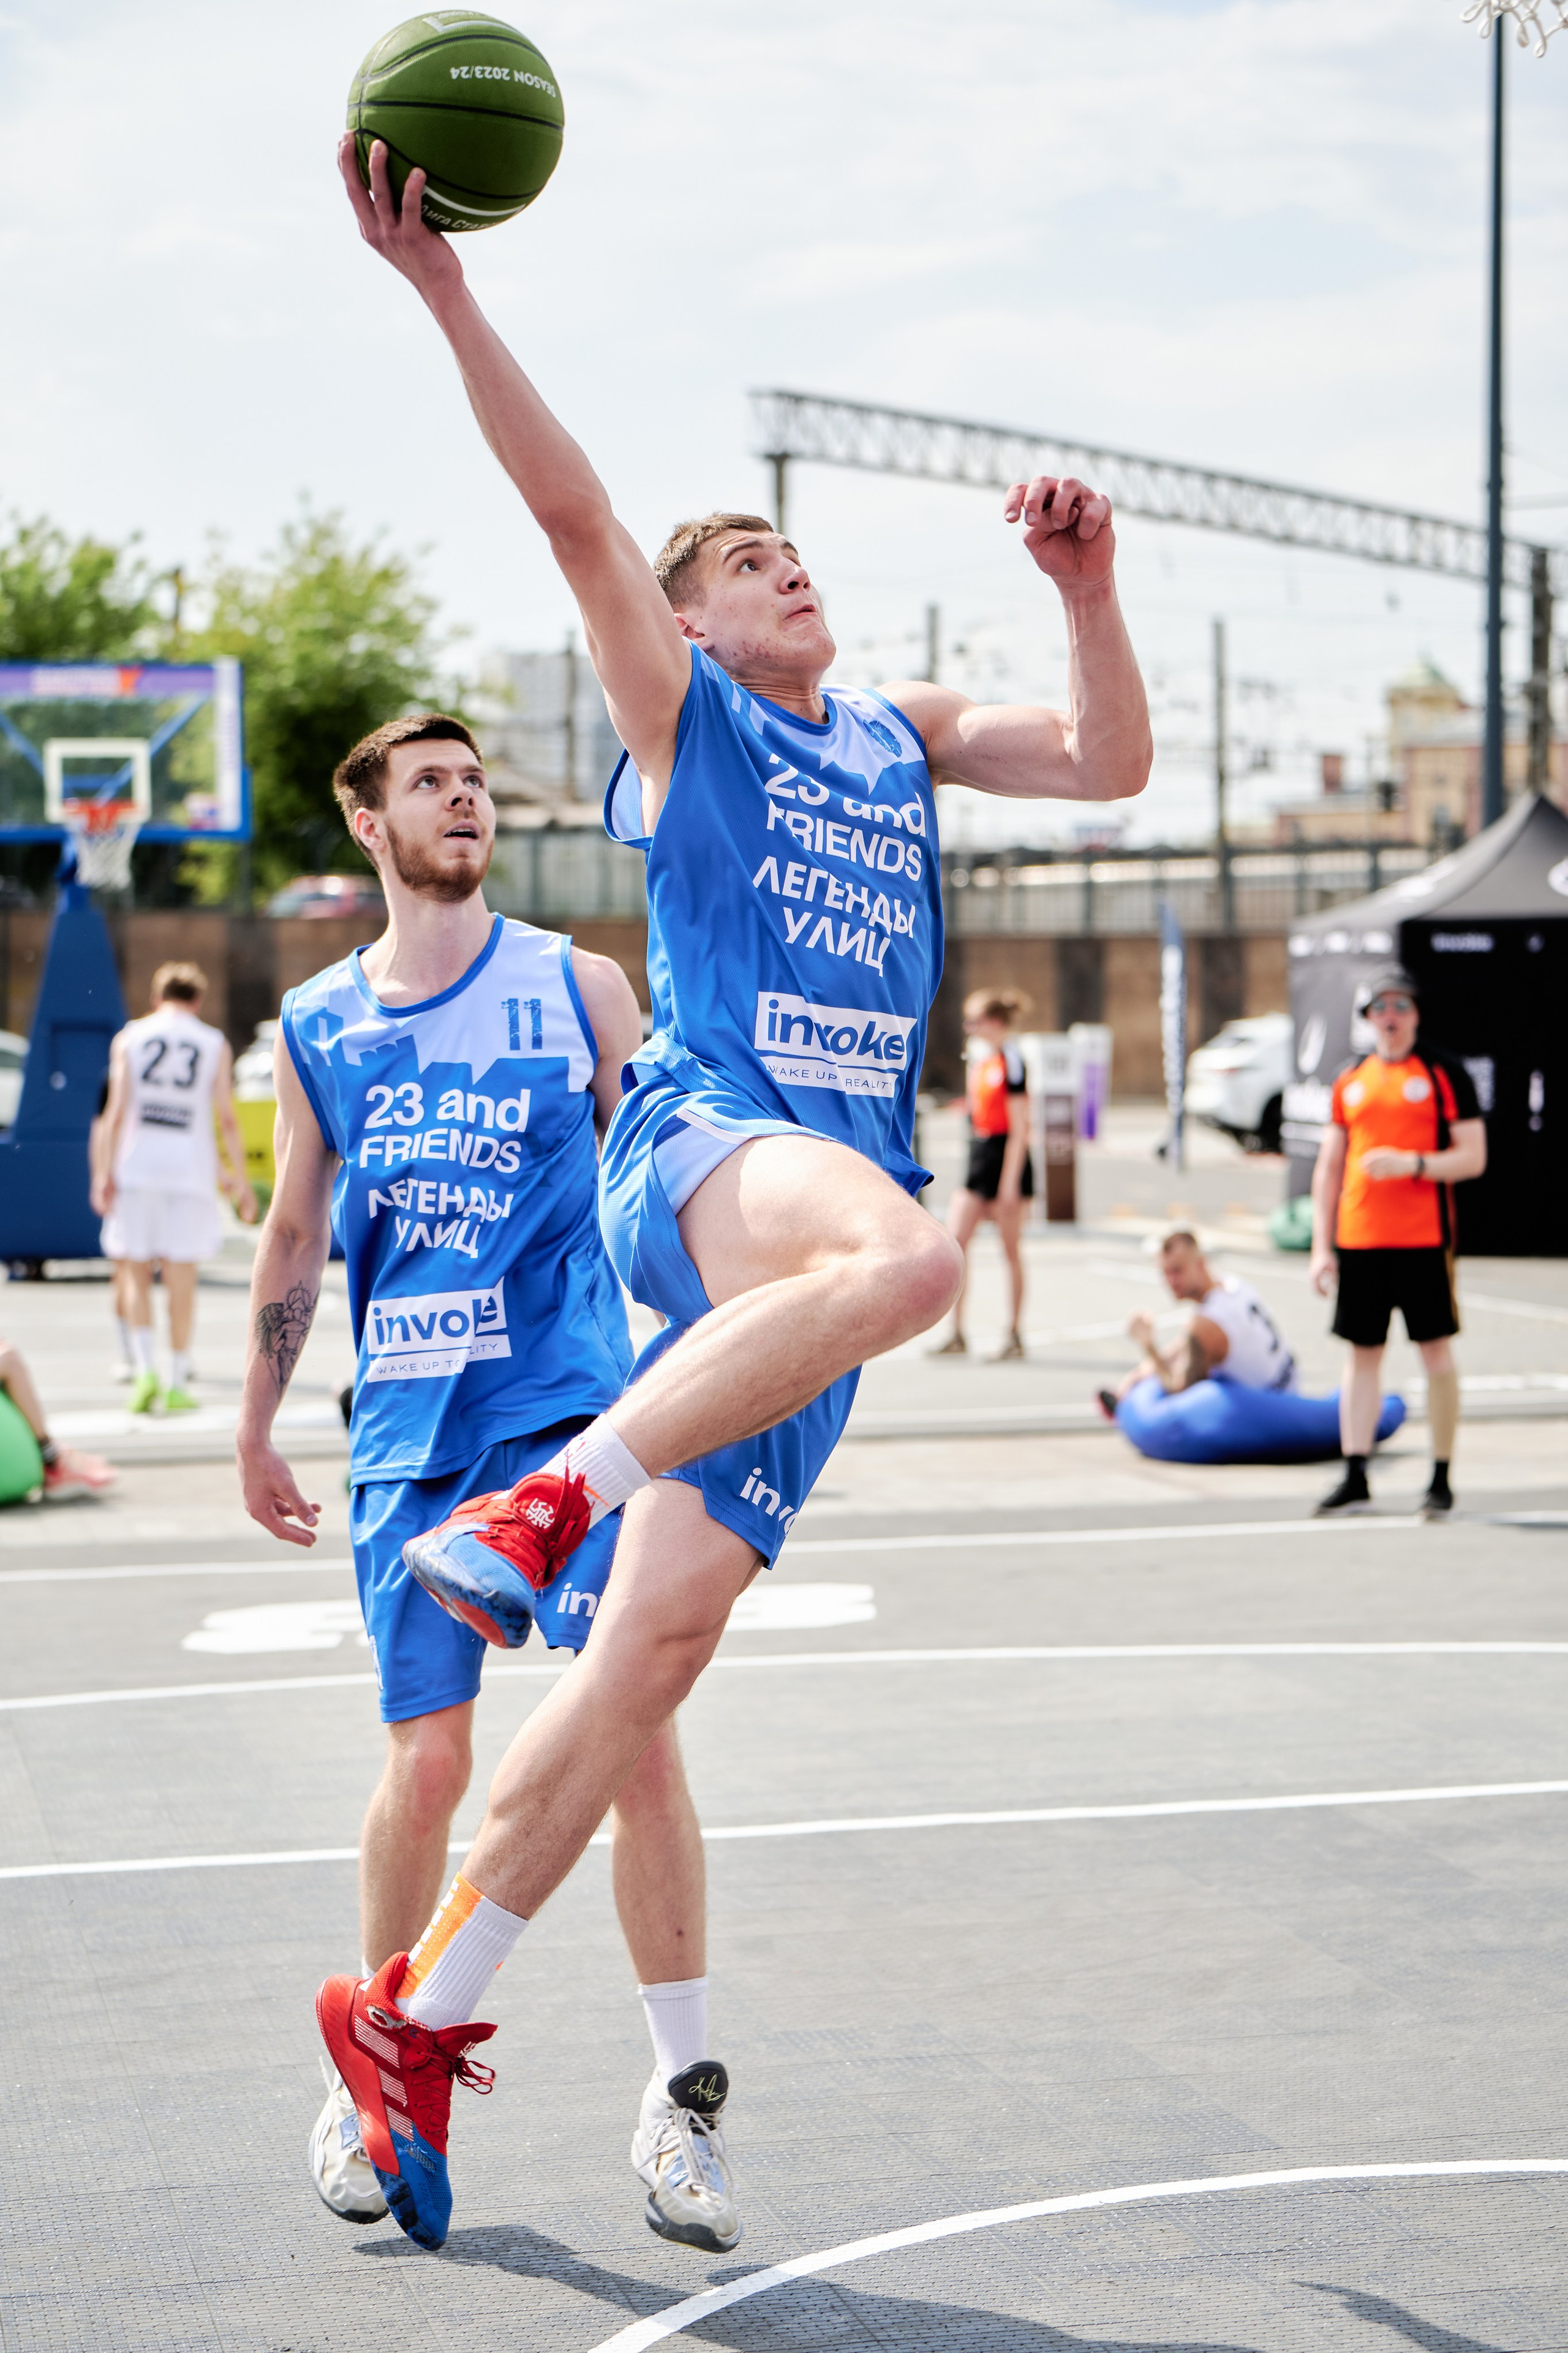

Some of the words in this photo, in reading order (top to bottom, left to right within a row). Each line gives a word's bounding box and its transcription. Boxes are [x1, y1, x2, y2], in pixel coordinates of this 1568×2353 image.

[450, 66, 510, 80] 2023/24
[513, 70, 556, 98] SEASON
[764, 753, 830, 806] 23
[843, 791, 926, 837] and
[766, 798, 922, 882] FRIENDS
[753, 856, 916, 939] ЛЕГЕНДЫ
[783, 907, 891, 977] УЛИЦ
[501, 999, 543, 1050] 11
[768, 999, 905, 1060] invoke
[141, 1038, 200, 1089] 23
[768, 1065, 810, 1078] WAKE
[816, 1071, 838, 1081] UP
[845, 1078, 892, 1090] REALITY
[364, 1082, 424, 1129] 23
[436, 1089, 531, 1133] and
[360, 1128, 522, 1174] FRIENDS
[369, 1178, 514, 1223] ЛЕГЕНДЫ
[396, 1215, 481, 1258] УЛИЦ
[376, 1362, 418, 1374] WAKE
[423, 1361, 439, 1370] UP
